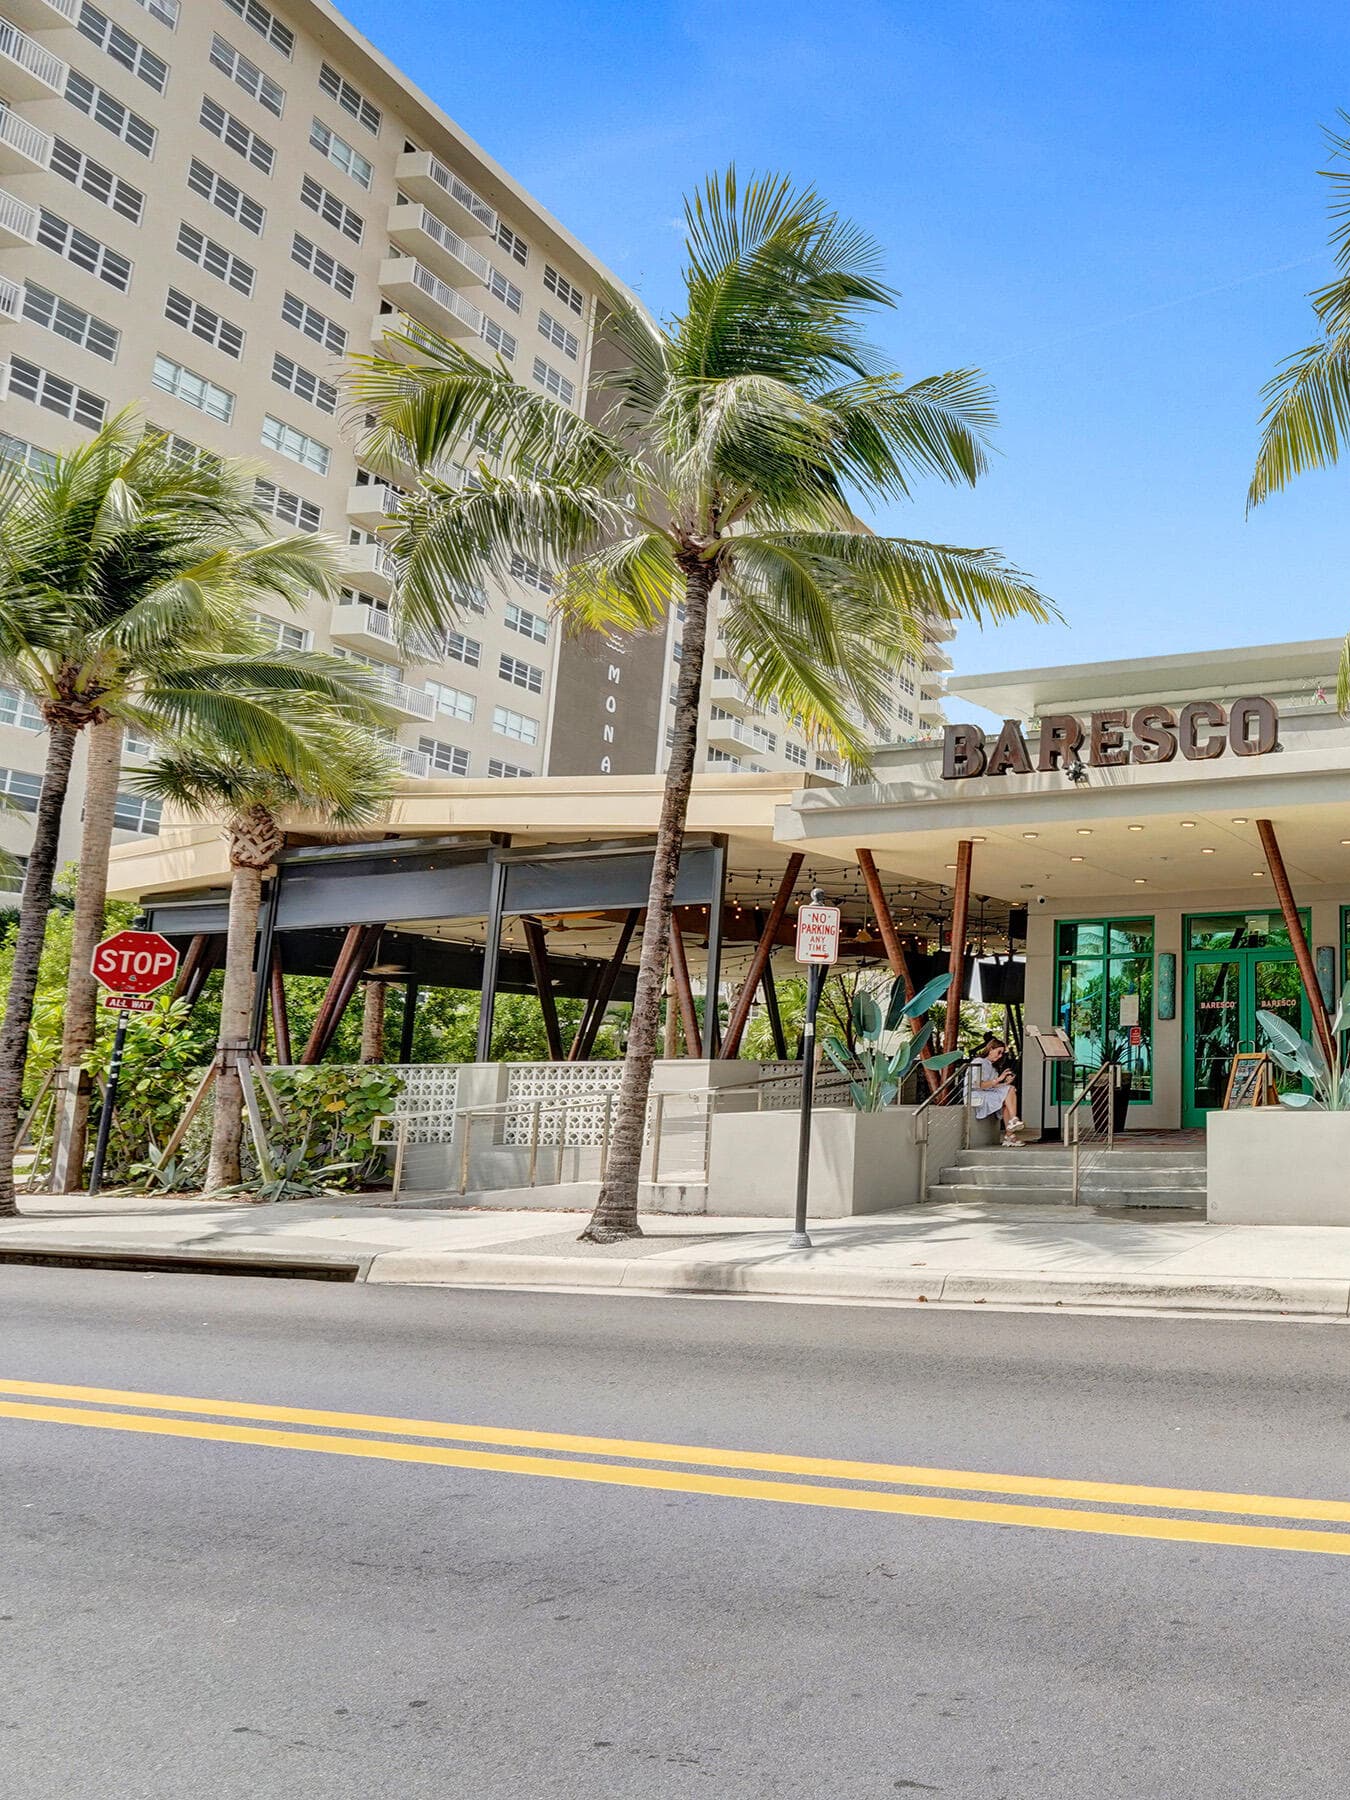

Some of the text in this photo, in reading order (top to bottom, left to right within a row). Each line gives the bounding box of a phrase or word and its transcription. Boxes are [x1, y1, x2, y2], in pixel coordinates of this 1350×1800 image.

[940, 696, 1279, 779] BARESCO
[811, 912, 827, 923] NO
[801, 923, 836, 936] PARKING
[809, 935, 826, 943] ANY
[808, 943, 827, 952] TIME
[97, 949, 173, 975] STOP
[109, 998, 151, 1010] ALL WAY
[1200, 1001, 1236, 1009] BARESCO
[1261, 999, 1297, 1008] BARESCO
